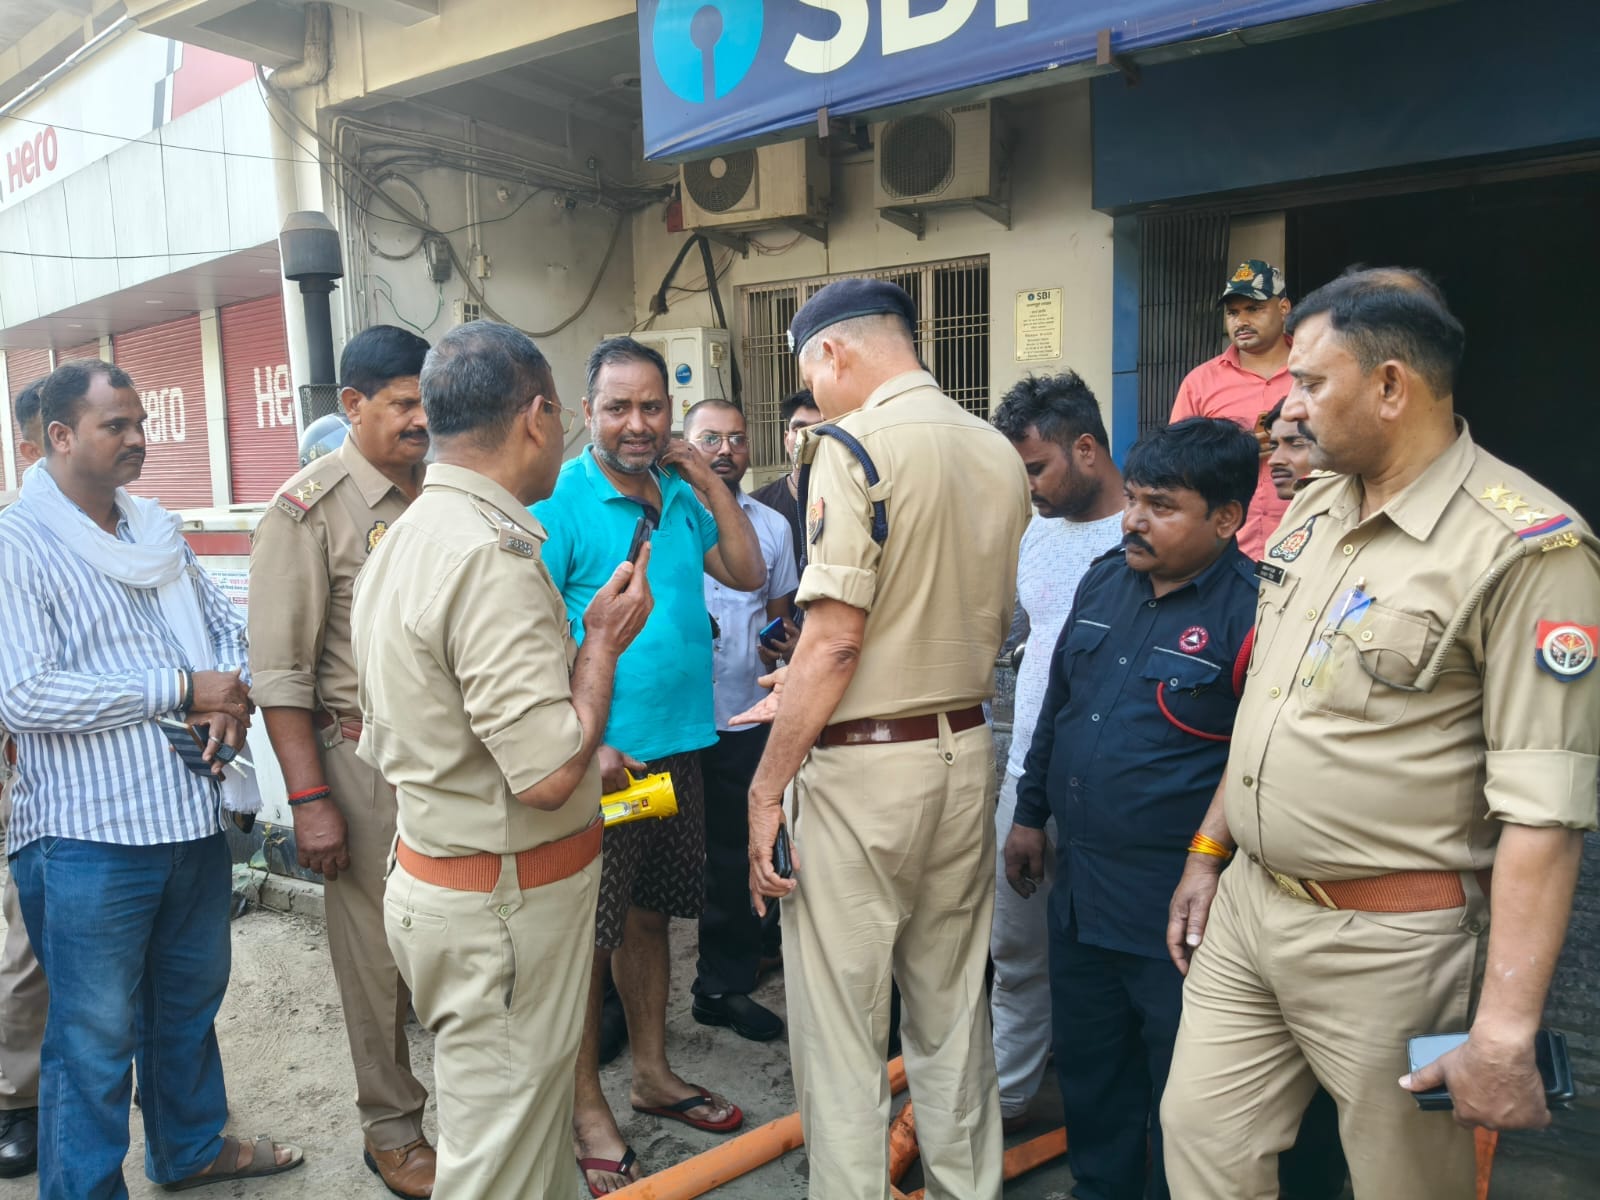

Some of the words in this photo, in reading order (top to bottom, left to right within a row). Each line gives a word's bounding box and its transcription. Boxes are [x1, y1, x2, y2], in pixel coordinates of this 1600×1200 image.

[6, 126, 58, 193] Hero
[1036, 292, 1051, 300] SBI
[253, 364, 294, 429] He
